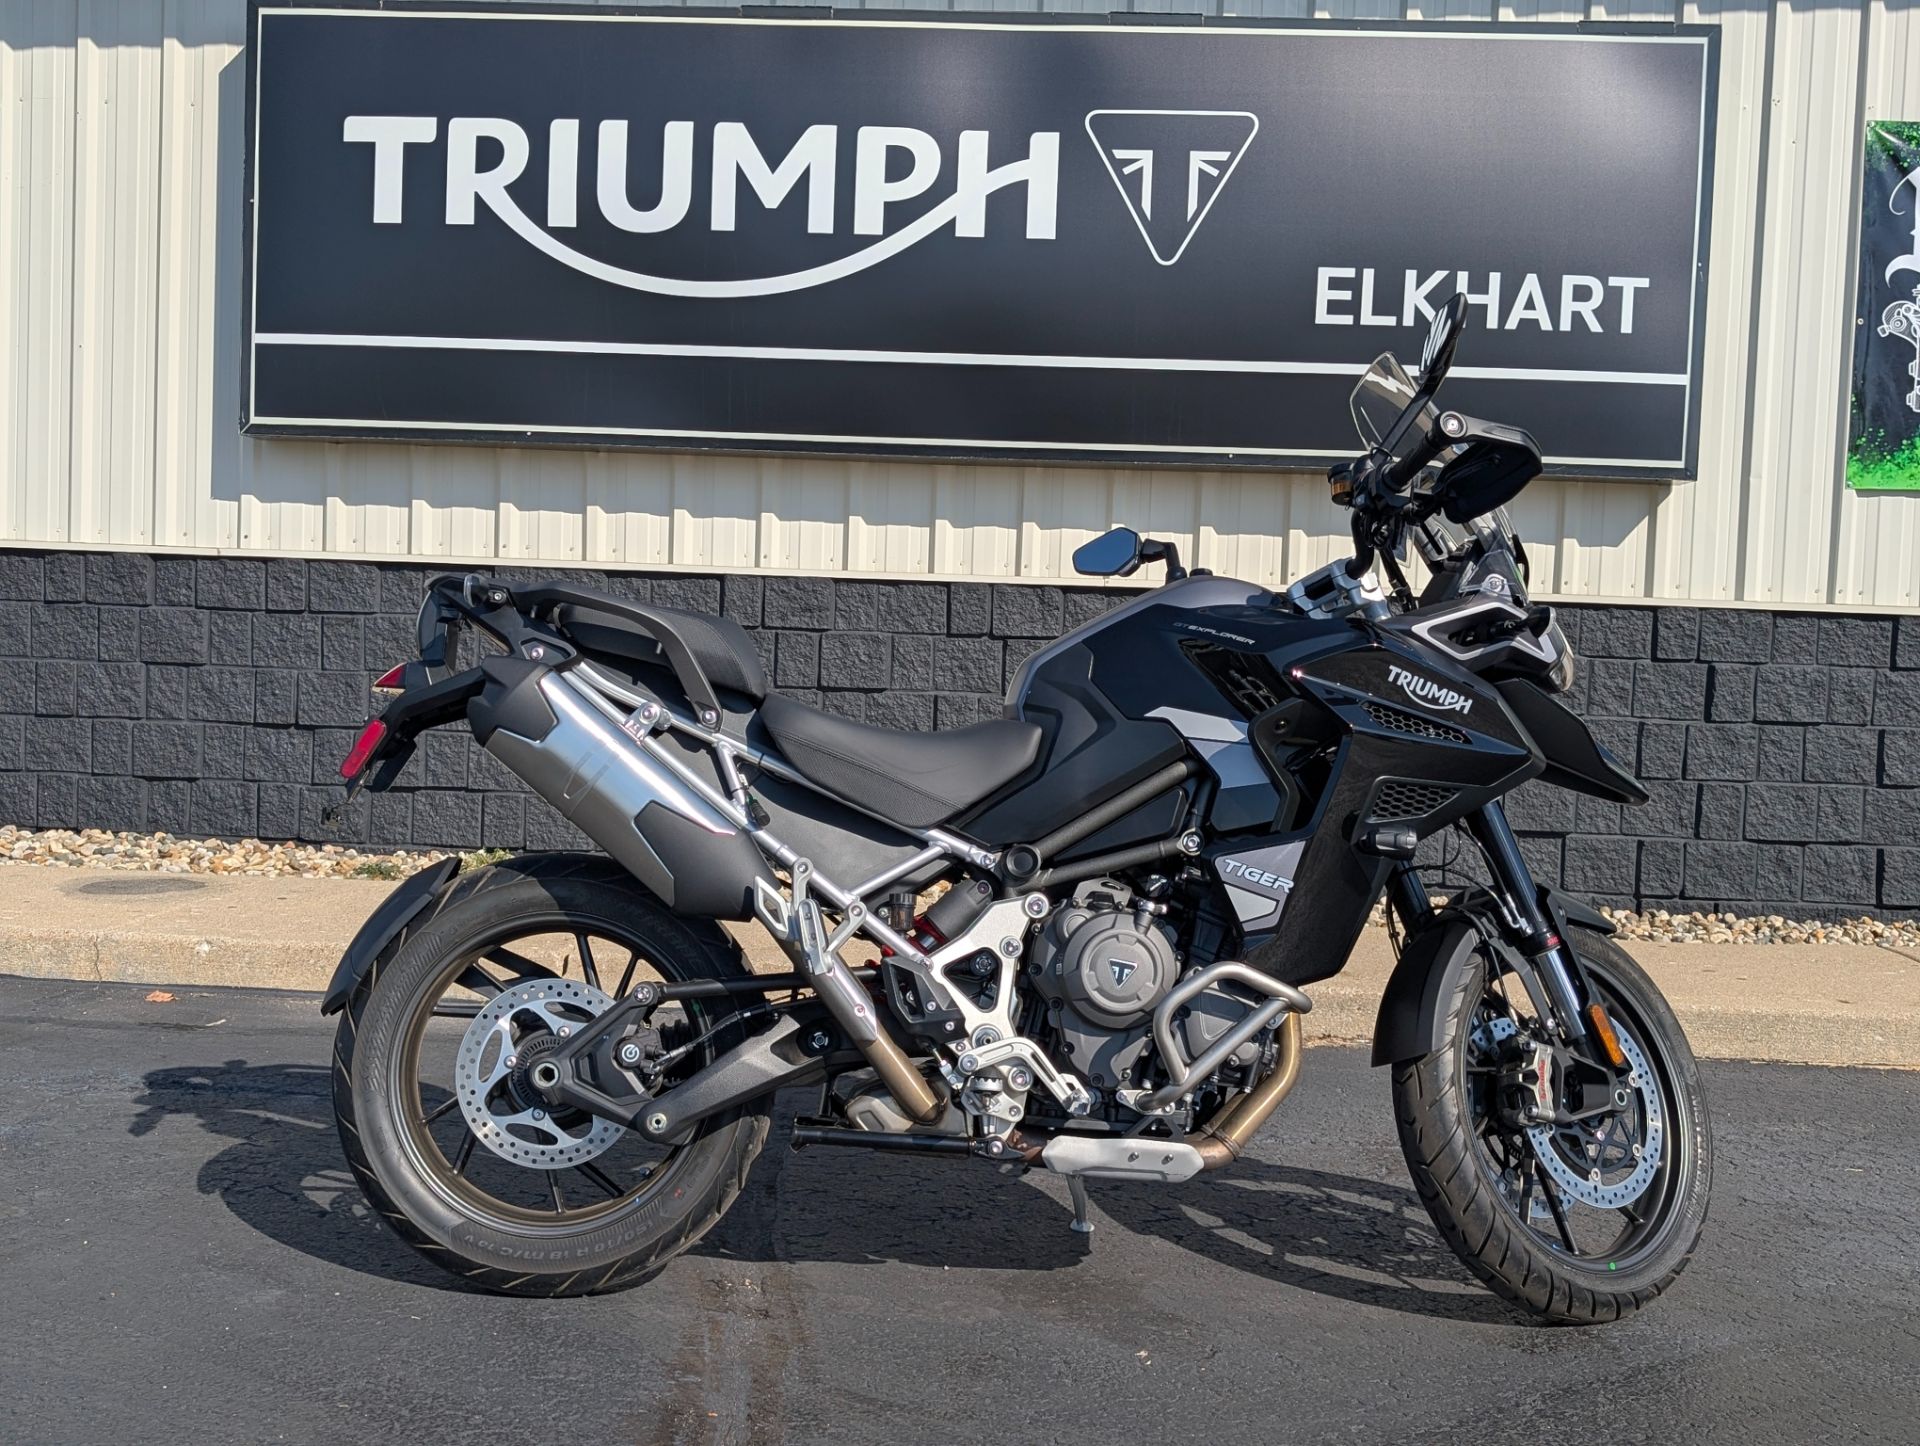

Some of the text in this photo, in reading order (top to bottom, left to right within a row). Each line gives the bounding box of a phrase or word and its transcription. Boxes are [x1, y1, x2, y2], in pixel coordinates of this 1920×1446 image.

[343, 115, 1060, 298] TRIUMPH
[1314, 266, 1650, 334] ELKHART
[1387, 664, 1473, 715] TRIUMPH
[1224, 859, 1295, 894] TIGER
